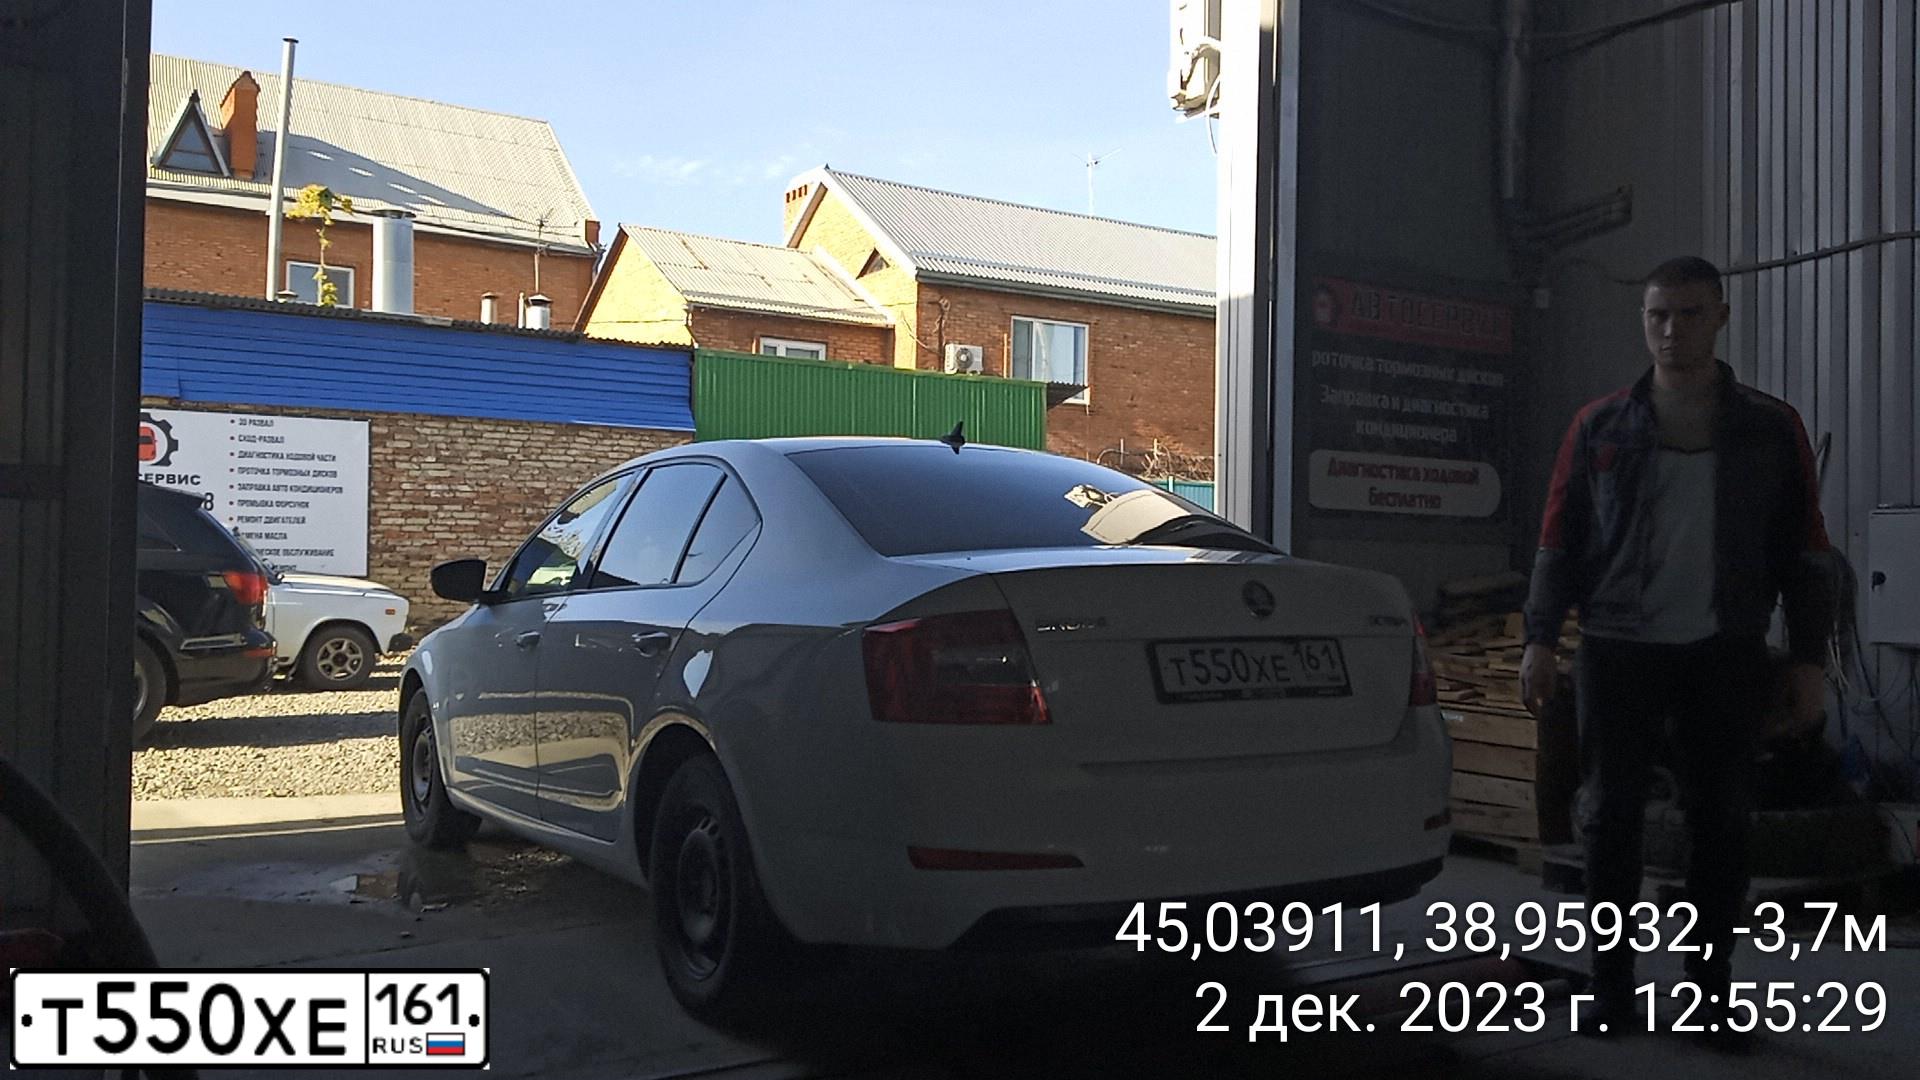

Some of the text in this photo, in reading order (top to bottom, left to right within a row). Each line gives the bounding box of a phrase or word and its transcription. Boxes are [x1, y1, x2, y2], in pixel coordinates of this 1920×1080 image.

[1312, 350, 1374, 371] роточка
[1320, 384, 1488, 419] Заправка и диагностика
[238, 450, 284, 459] ДИАГНОСТИКА
[1328, 457, 1420, 481] Диагностика
[265, 532, 288, 540] МАСЛА
[1293, 640, 1336, 671] 161
